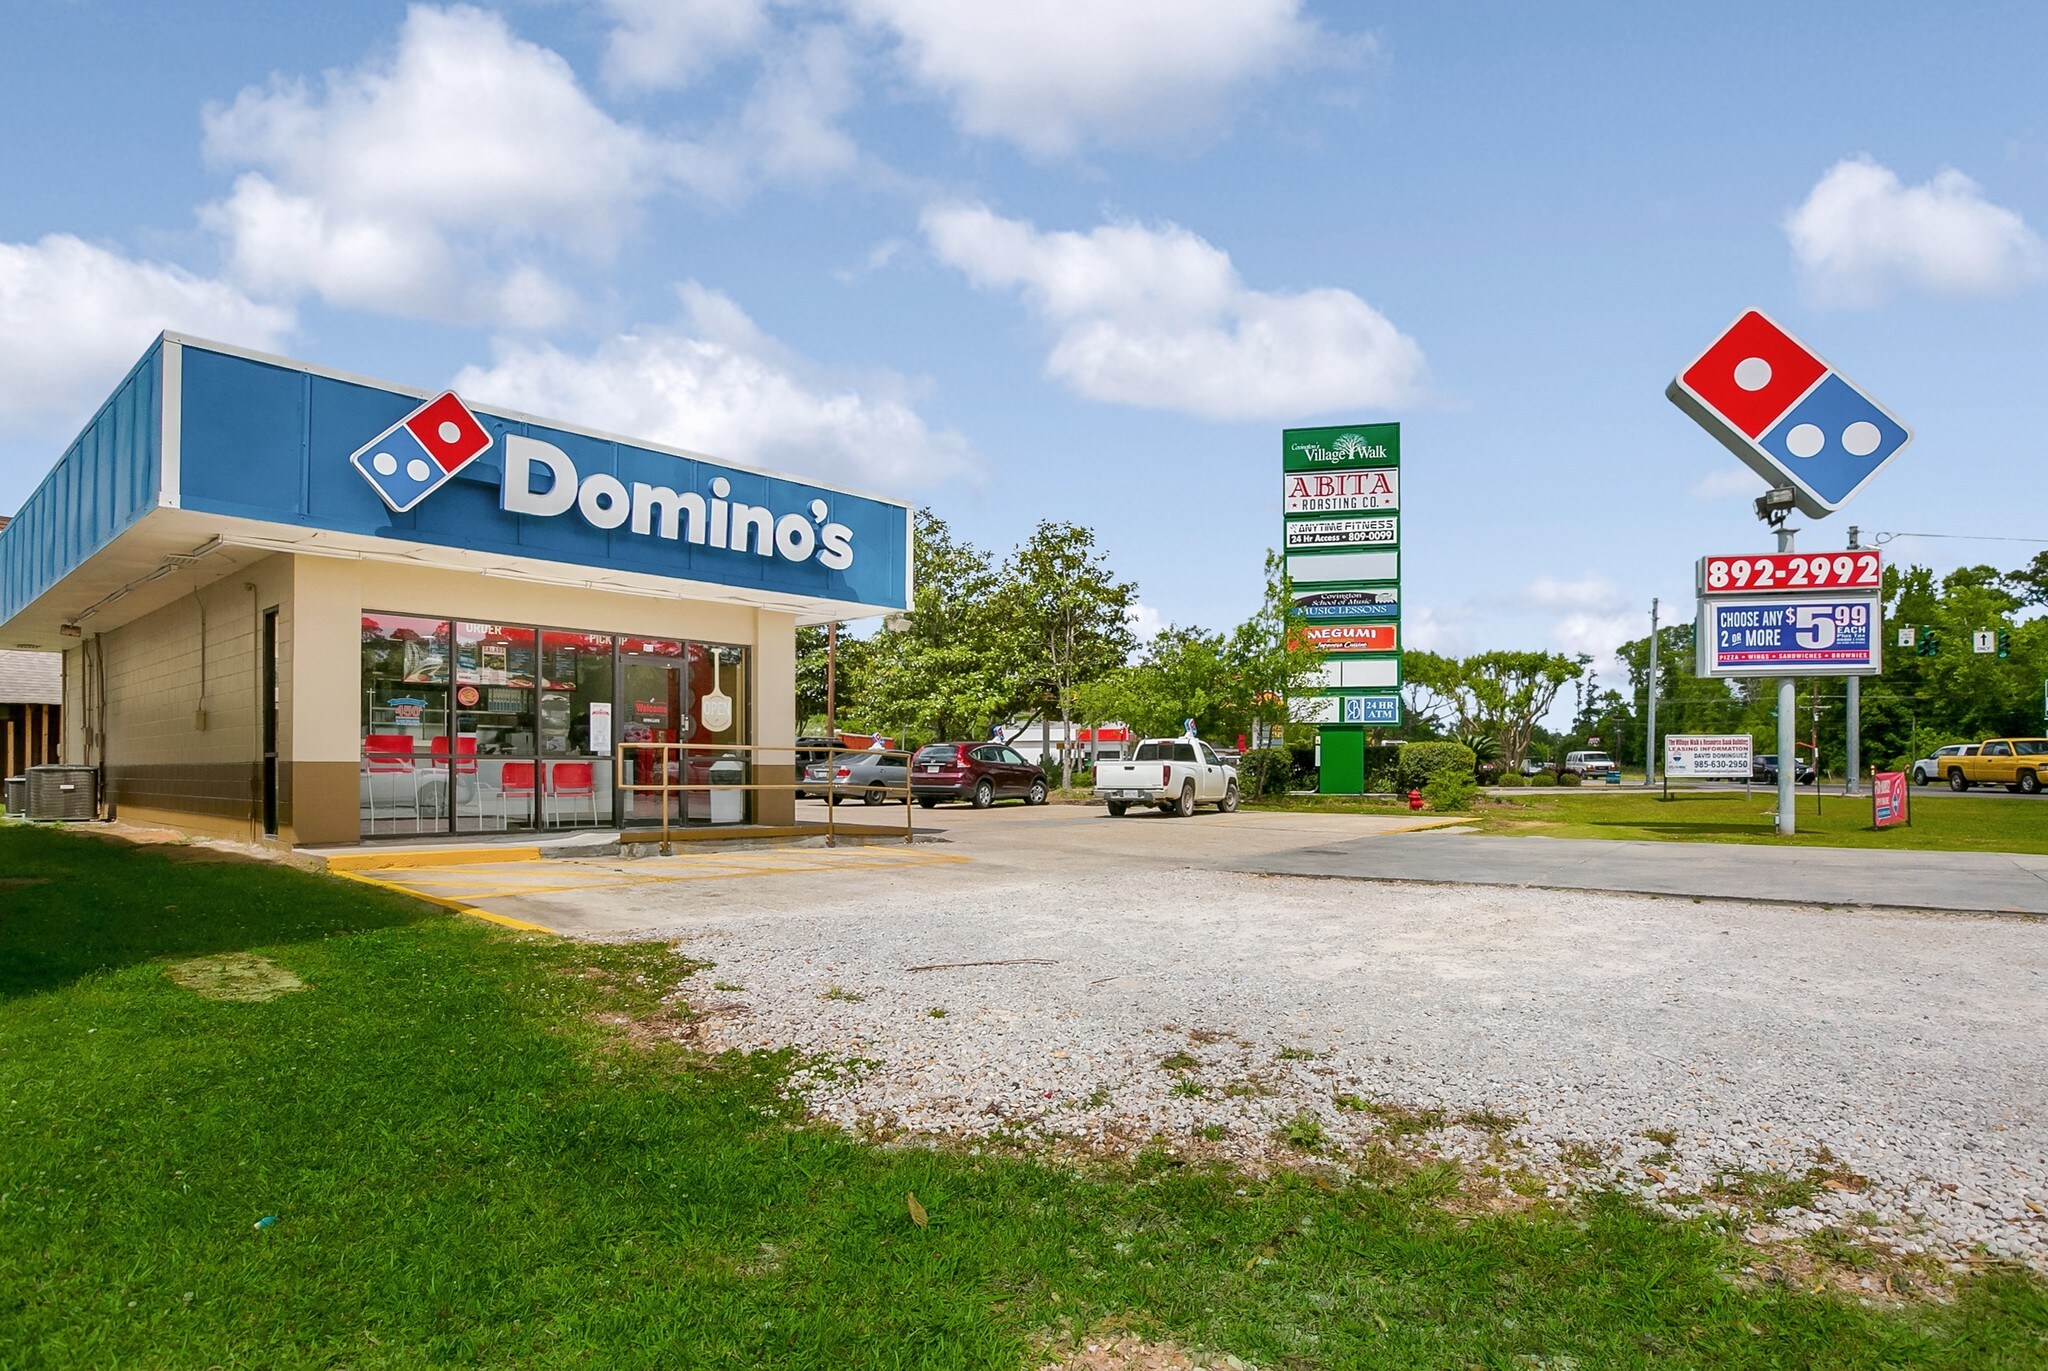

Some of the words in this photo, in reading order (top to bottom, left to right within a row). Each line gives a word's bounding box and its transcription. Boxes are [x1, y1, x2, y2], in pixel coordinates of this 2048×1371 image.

[1304, 449, 1346, 464] Village
[1357, 445, 1388, 459] Walk
[1288, 473, 1393, 498] ABITA
[500, 433, 854, 571] Domino's
[1302, 497, 1357, 510] ROASTING
[1362, 497, 1379, 508] CO.
[1298, 522, 1343, 533] ANYTIME
[1344, 520, 1393, 530] FITNESS
[1291, 535, 1302, 543] 24
[1303, 535, 1313, 543] Hr
[1314, 534, 1340, 543] Access
[1348, 531, 1392, 542] 809-0099
[1709, 555, 1878, 588] 892-2992
[1321, 593, 1362, 603] Covington
[1297, 607, 1336, 616] MUSIC
[1338, 605, 1387, 614] LESSONS
[1720, 611, 1759, 628] CHOOSE
[1762, 610, 1784, 627] ANY
[1308, 628, 1376, 639] MEGUMI
[1837, 626, 1865, 634] EACH
[1721, 630, 1729, 647] 2
[1732, 632, 1742, 643] OR
[1745, 629, 1781, 646] MORE
[635, 703, 667, 713] Welcome
[703, 702, 730, 716] OPEN
[1366, 701, 1377, 709] 24
[1379, 700, 1394, 709] HR
[1368, 710, 1392, 719] ATM
[1694, 760, 1748, 768] 985-630-2950
